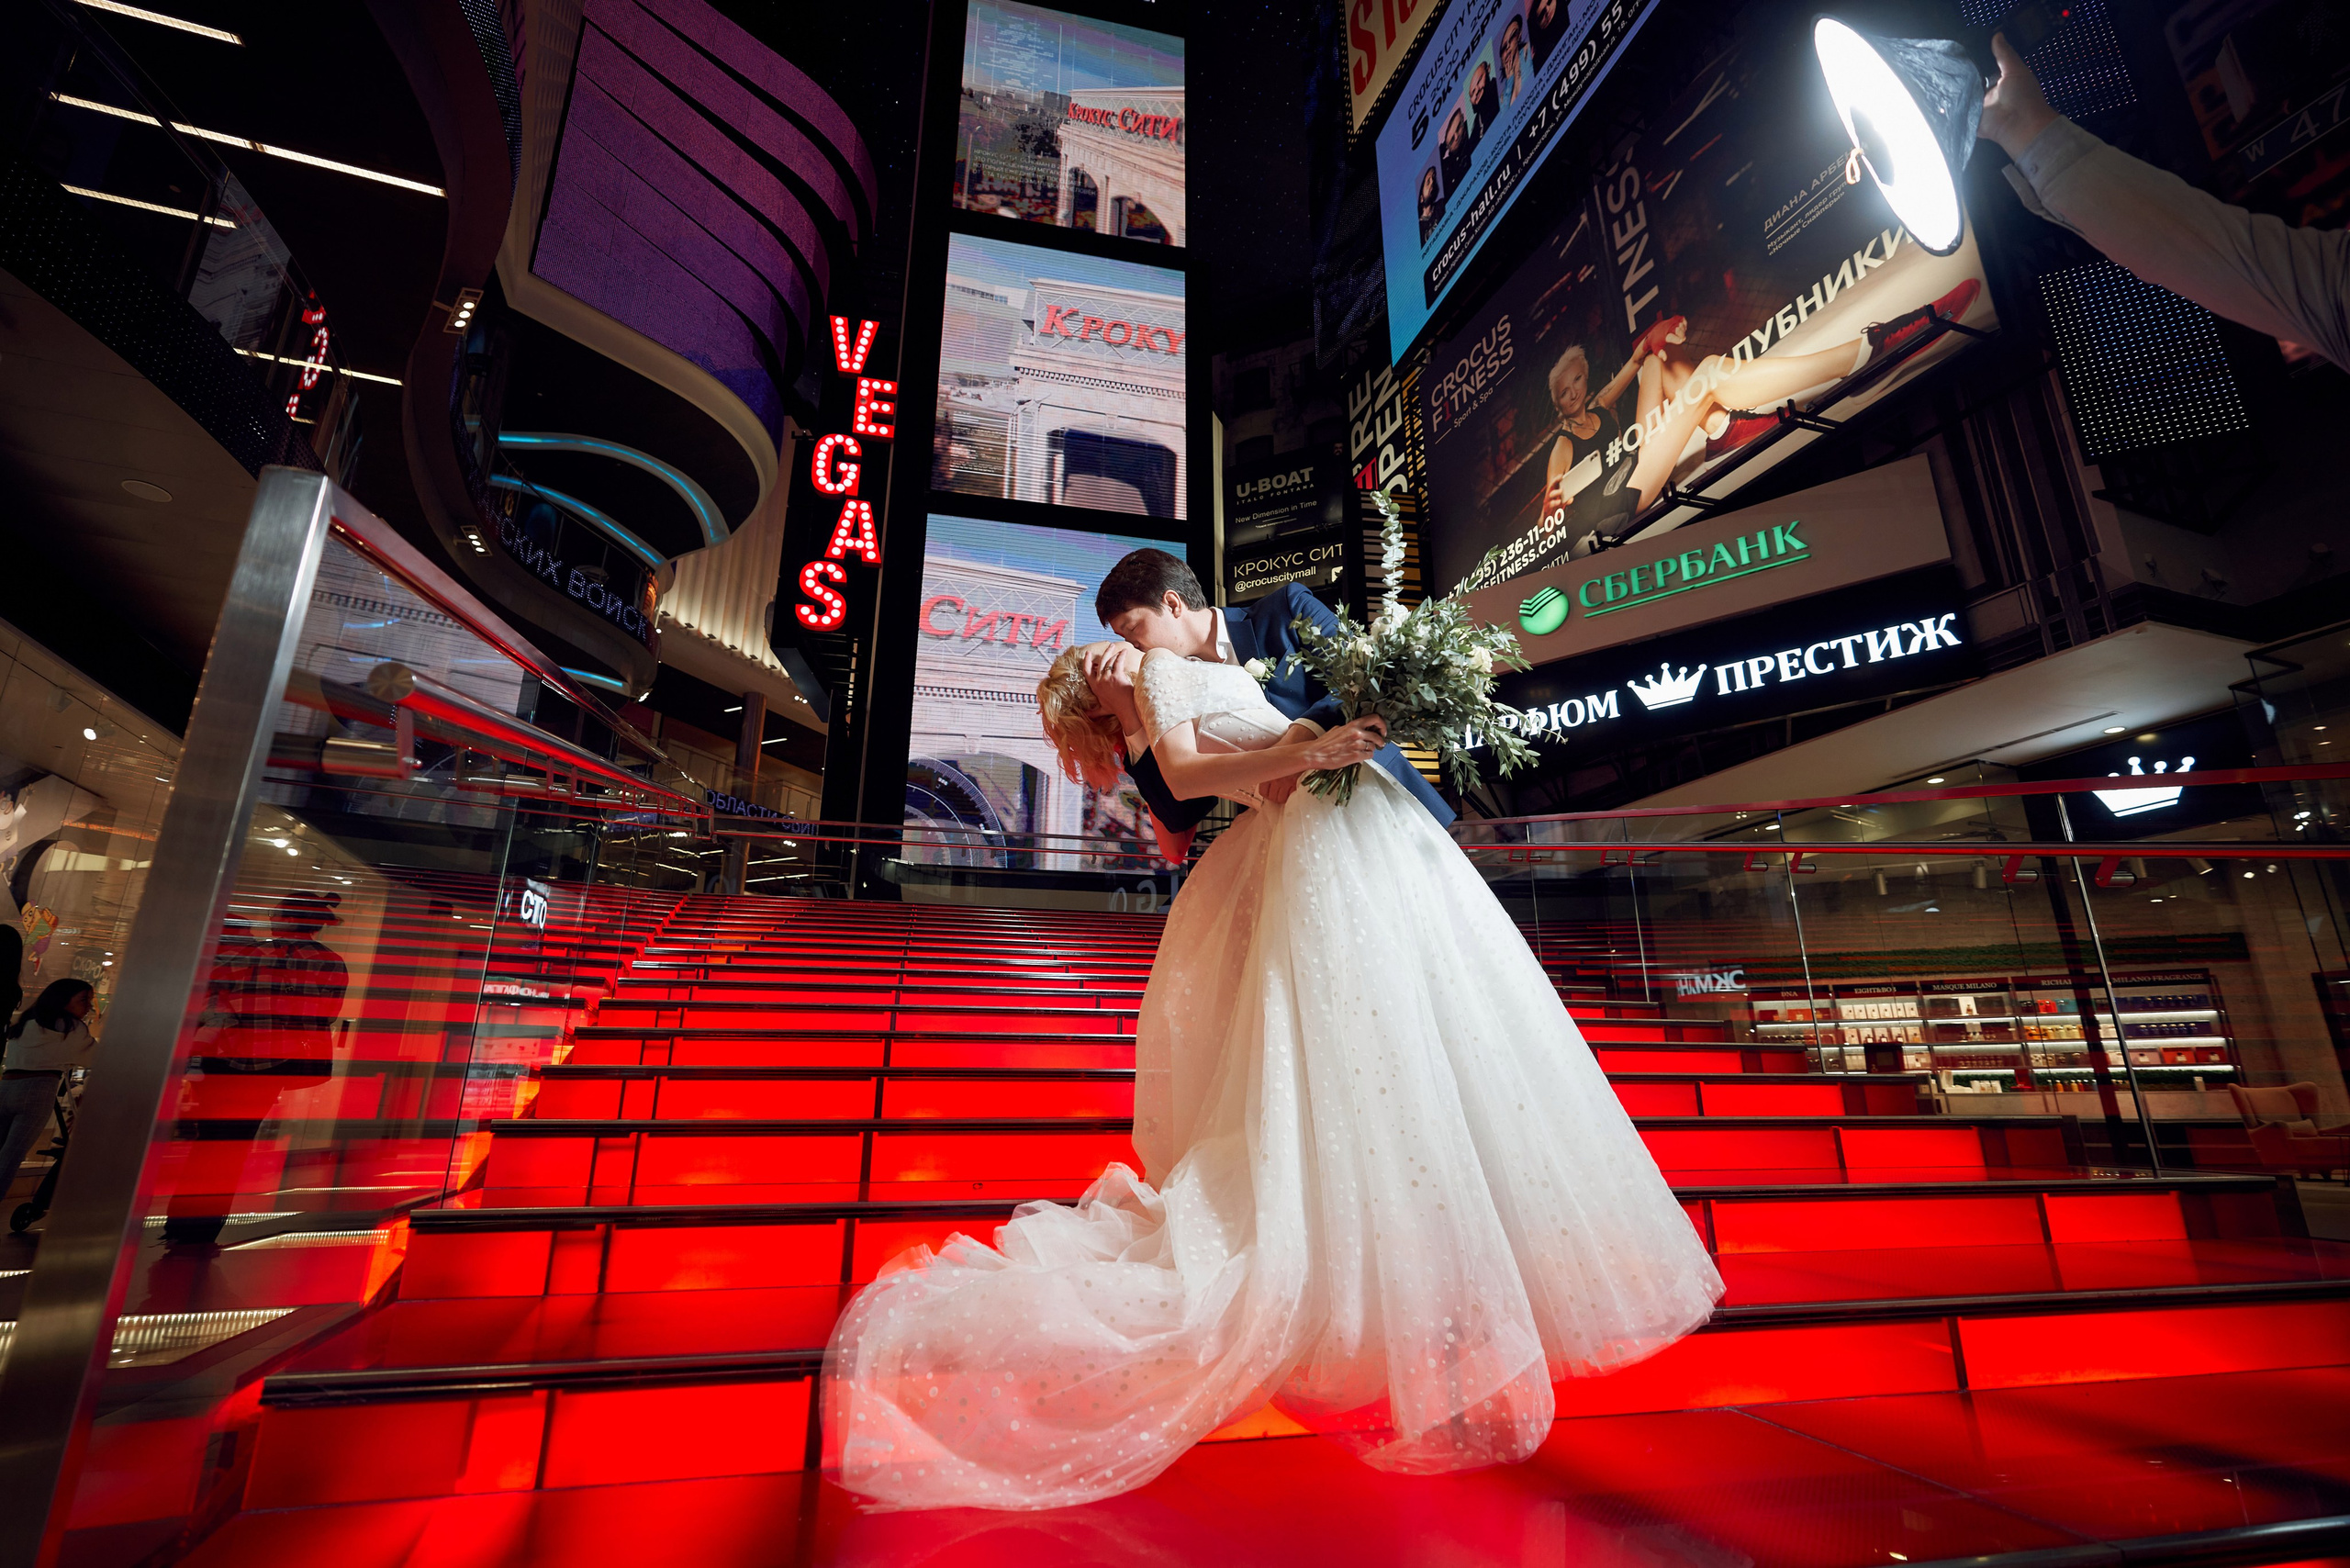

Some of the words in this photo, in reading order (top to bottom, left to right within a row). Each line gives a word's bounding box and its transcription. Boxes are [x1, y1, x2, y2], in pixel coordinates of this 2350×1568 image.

[1408, 50, 1444, 120] CROCUS
[1445, 9, 1465, 55] CITY
[1411, 105, 1429, 151] 5
[1432, 0, 1503, 118] ОКТЯБРЯ
[1547, 23, 1579, 74] ДЖИГАН
[1430, 49, 1460, 103] 20:00
[1432, 164, 1511, 282] crocus-hall.ru
[1529, 106, 1547, 138] +7
[1552, 39, 1596, 111] (499)
[1764, 188, 1807, 232] ДИАНА
[1767, 218, 1804, 250] Музыкант,
[1804, 196, 1828, 219] лидер
[1768, 227, 1801, 256] «Ночные
[1801, 190, 1845, 229] Снайперы»
[1431, 314, 1512, 408] CROCUS
[1606, 225, 1914, 468] #ОДНОКЛУБНИКИ
[1453, 407, 1472, 429] Sport
[1472, 400, 1479, 410] &
[1479, 386, 1494, 404] Spa
[795, 315, 898, 632] VEGAS
[1236, 466, 1314, 498] U-BOAT
[1237, 495, 1264, 506] ITALO
[1270, 483, 1315, 498] FONTANA
[1235, 515, 1251, 524] New
[1252, 506, 1290, 521] Dimension
[1300, 499, 1317, 510] Time
[1499, 508, 1565, 567] 236-11-00
[496, 514, 565, 588] СКИХ
[567, 567, 650, 643] ВОЙСК
[1234, 553, 1304, 579] КРОКУС
[1235, 566, 1316, 593] @crocuscitymall
[1577, 520, 1810, 610] СБЕРБАНК
[1713, 611, 1963, 696] ПРЕСТИЖ
[73, 956, 105, 980] СКОРО
[1931, 982, 1964, 992] MASQUE
[1965, 981, 1998, 991] MILANO
[2112, 975, 2153, 984] MILANO
[2153, 972, 2204, 983] FRAGRANZE
